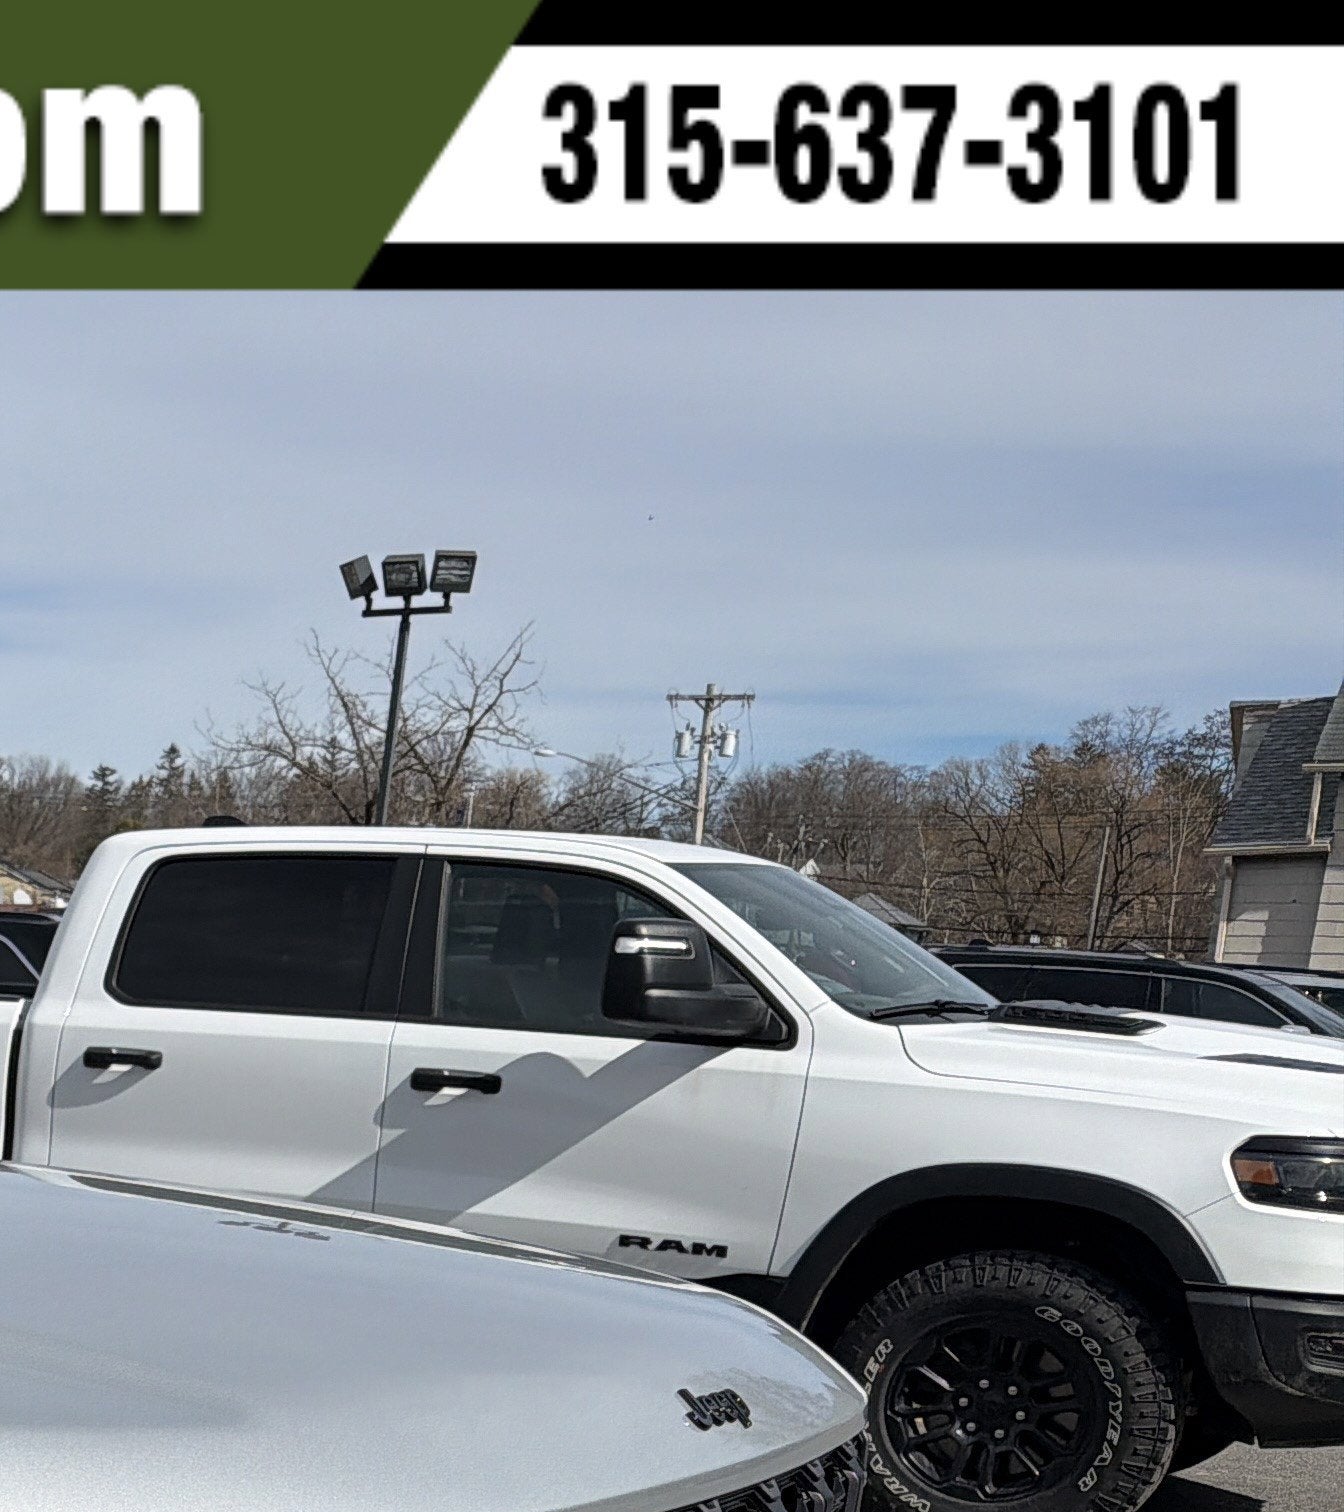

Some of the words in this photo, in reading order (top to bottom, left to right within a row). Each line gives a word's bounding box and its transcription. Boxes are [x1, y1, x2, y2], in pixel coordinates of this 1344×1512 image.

[618, 1234, 728, 1258] RAM
[676, 1388, 753, 1431] Jeep
[1034, 1306, 1123, 1492] GOODYEAR
